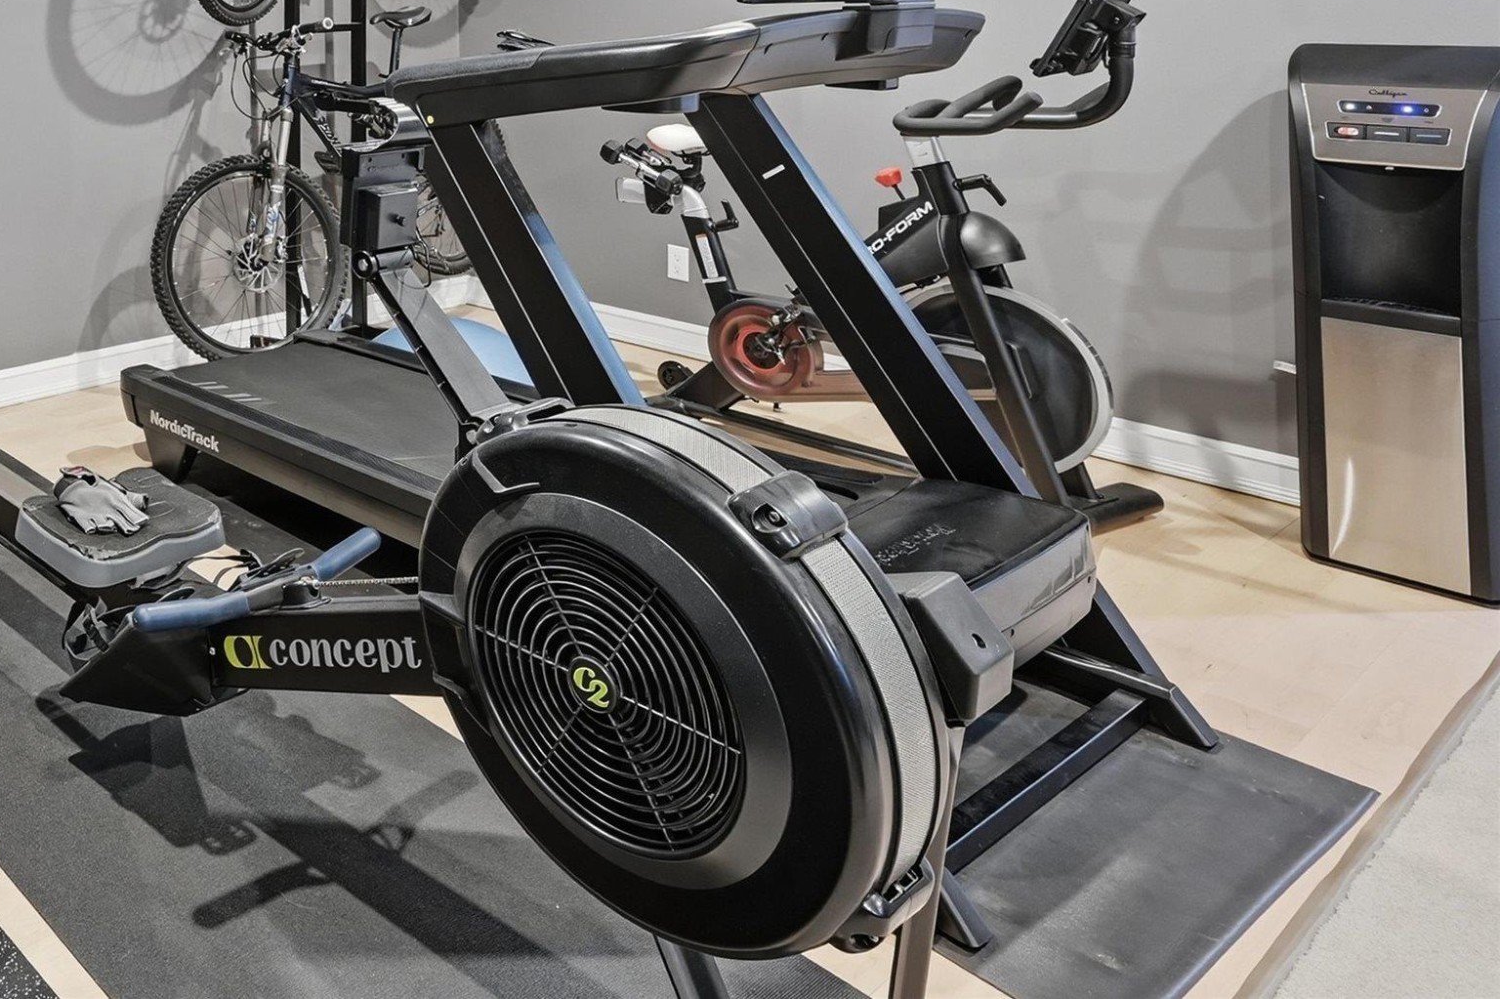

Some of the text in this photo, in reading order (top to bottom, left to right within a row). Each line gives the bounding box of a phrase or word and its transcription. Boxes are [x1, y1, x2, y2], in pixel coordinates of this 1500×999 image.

[867, 201, 934, 255] O-FORM
[150, 409, 220, 453] NordicTrack
[269, 636, 422, 673] concept
[573, 667, 610, 708] C2
